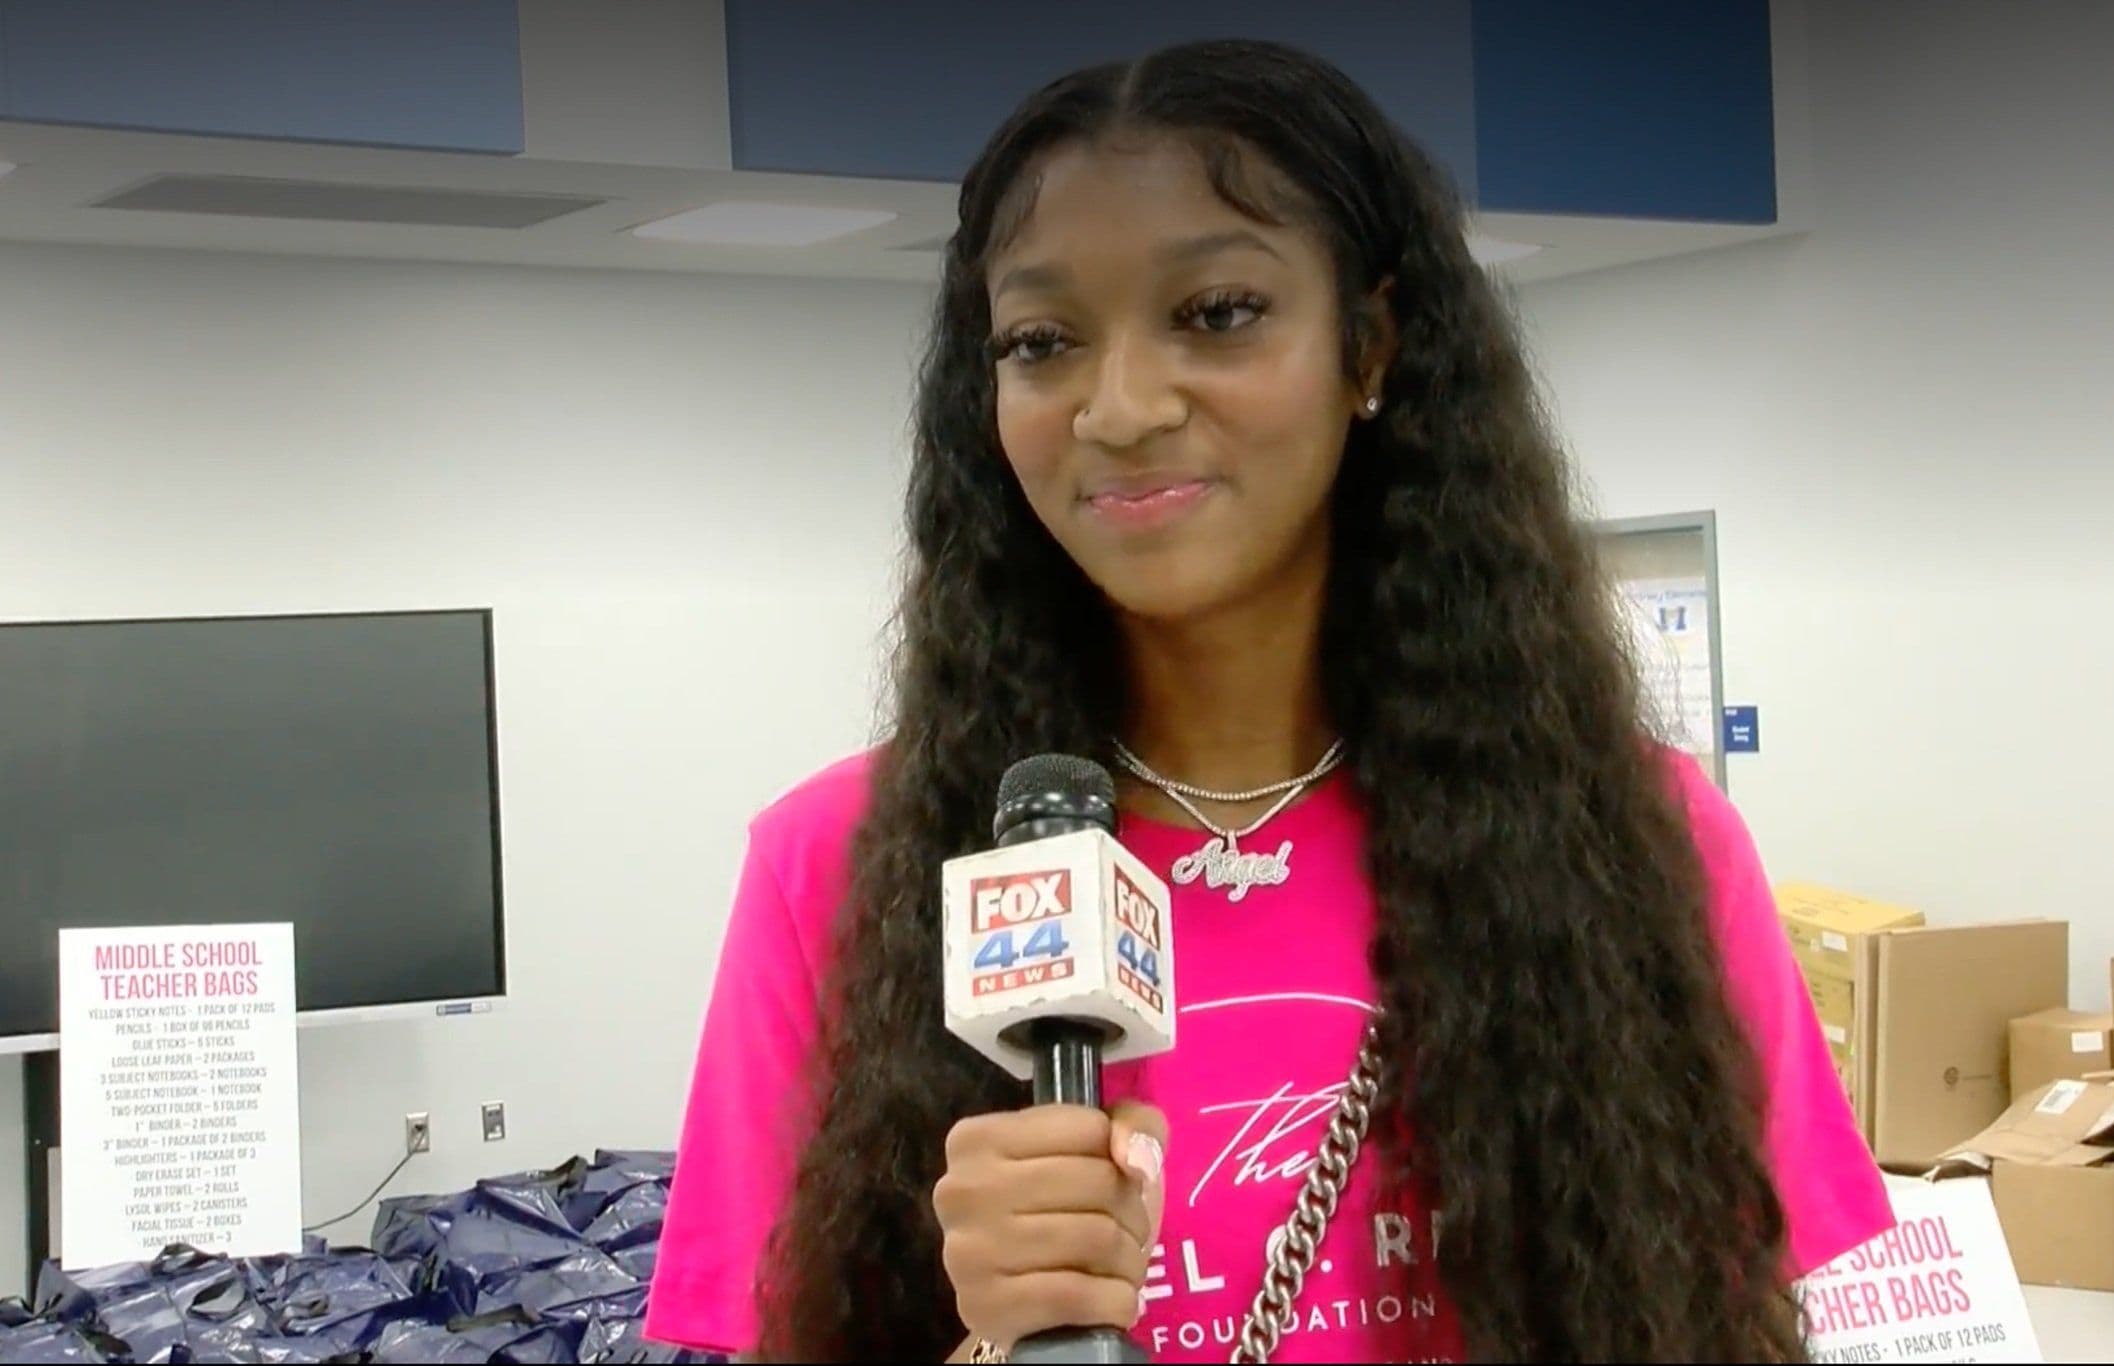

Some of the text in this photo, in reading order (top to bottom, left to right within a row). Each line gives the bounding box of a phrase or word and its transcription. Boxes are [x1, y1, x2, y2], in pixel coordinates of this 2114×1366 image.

[1171, 839, 1293, 902] Angel
[976, 872, 1067, 929] FOX
[1116, 878, 1159, 947] FOX
[974, 919, 1070, 969] 44
[95, 941, 263, 971] MIDDLE SCHOOL
[1117, 930, 1161, 987] 44
[100, 971, 259, 1000] TEACHER BAGS
[977, 963, 1069, 994] NEWS
[87, 1007, 123, 1020] YELLOW
[125, 1006, 156, 1019] STICKY
[158, 1004, 186, 1017] NOTES
[198, 1004, 202, 1016] 1
[203, 1003, 225, 1015] PACK
[228, 1002, 238, 1014] OF
[242, 1002, 251, 1014] 12
[253, 1001, 275, 1014] PADS
[115, 1022, 152, 1035] PENCILS
[163, 1021, 167, 1033] 1
[170, 1020, 187, 1033] BOX
[189, 1020, 199, 1032] OF
[215, 1018, 250, 1031] PENCILS
[156, 1037, 186, 1050] STICKS
[205, 1035, 235, 1048] STICKS
[111, 1055, 138, 1068] LOOSE
[141, 1054, 162, 1067] LEAF
[164, 1053, 193, 1066] PAPER
[203, 1051, 209, 1064] 2
[210, 1050, 256, 1063] PACKAGES
[108, 1071, 145, 1084] SUBJECT
[147, 1070, 199, 1082] NOTEBOOKS
[209, 1068, 215, 1081] 2
[217, 1066, 267, 1079] NOTEBOOKS
[114, 1087, 151, 1100] SUBJECT
[153, 1085, 199, 1098] NOTEBOOK
[211, 1084, 216, 1096] 1
[217, 1083, 262, 1096] NOTEBOOK
[168, 1101, 202, 1114] FOLDER
[220, 1099, 259, 1112] FOLDERS
[149, 1118, 182, 1131] BINDER
[192, 1118, 198, 1130] 2
[200, 1115, 237, 1129] BINDERS
[116, 1136, 149, 1150] BINDER
[161, 1135, 166, 1148] 1
[167, 1133, 207, 1147] PACKAGE
[208, 1132, 219, 1145] OF
[222, 1132, 228, 1144] 2
[229, 1130, 267, 1144] BINDERS
[114, 1151, 178, 1167] HIGHLIGHTERS
[190, 1150, 194, 1162] 1
[196, 1148, 235, 1161] PACKAGE
[237, 1147, 248, 1160] OF
[135, 1169, 154, 1182] DRY
[155, 1167, 182, 1180] ERASE
[186, 1167, 201, 1179] SET
[214, 1166, 218, 1178] 1
[220, 1164, 236, 1177] SET
[133, 1185, 162, 1199] PAPER
[165, 1183, 193, 1196] TOWEL
[204, 1182, 210, 1194] 2
[212, 1181, 240, 1193] ROLLS
[125, 1203, 151, 1216] LYSOL
[154, 1201, 181, 1214] WIPES
[193, 1199, 199, 1212] 2
[200, 1197, 248, 1211] CANISTERS
[131, 1219, 162, 1232] FACIAL
[164, 1216, 194, 1230] TISSUE
[206, 1214, 212, 1227] 2
[213, 1213, 242, 1227] BOXES
[226, 1230, 232, 1242] 3
[1142, 1240, 1225, 1300] EL
[1805, 1269, 1971, 1335] CHER BAGS
[1895, 1339, 1904, 1358] 1
[1905, 1333, 1939, 1356] PACK
[1938, 1330, 1954, 1351] OF
[1957, 1327, 1974, 1348] 12
[1975, 1323, 2007, 1345] PADS
